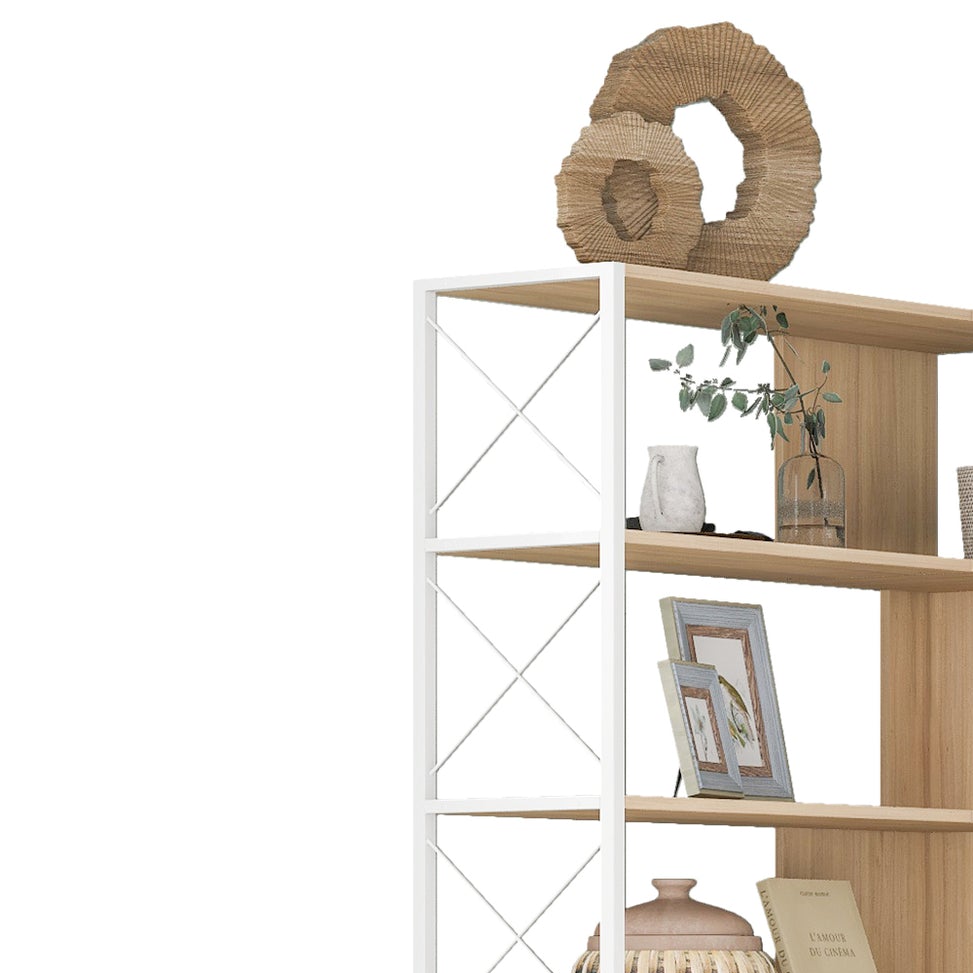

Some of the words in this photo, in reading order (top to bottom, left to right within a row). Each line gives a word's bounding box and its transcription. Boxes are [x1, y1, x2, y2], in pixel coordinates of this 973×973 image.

[809, 932, 847, 943] L'AMOUR
[809, 947, 822, 957] DU
[779, 949, 788, 967] DU
